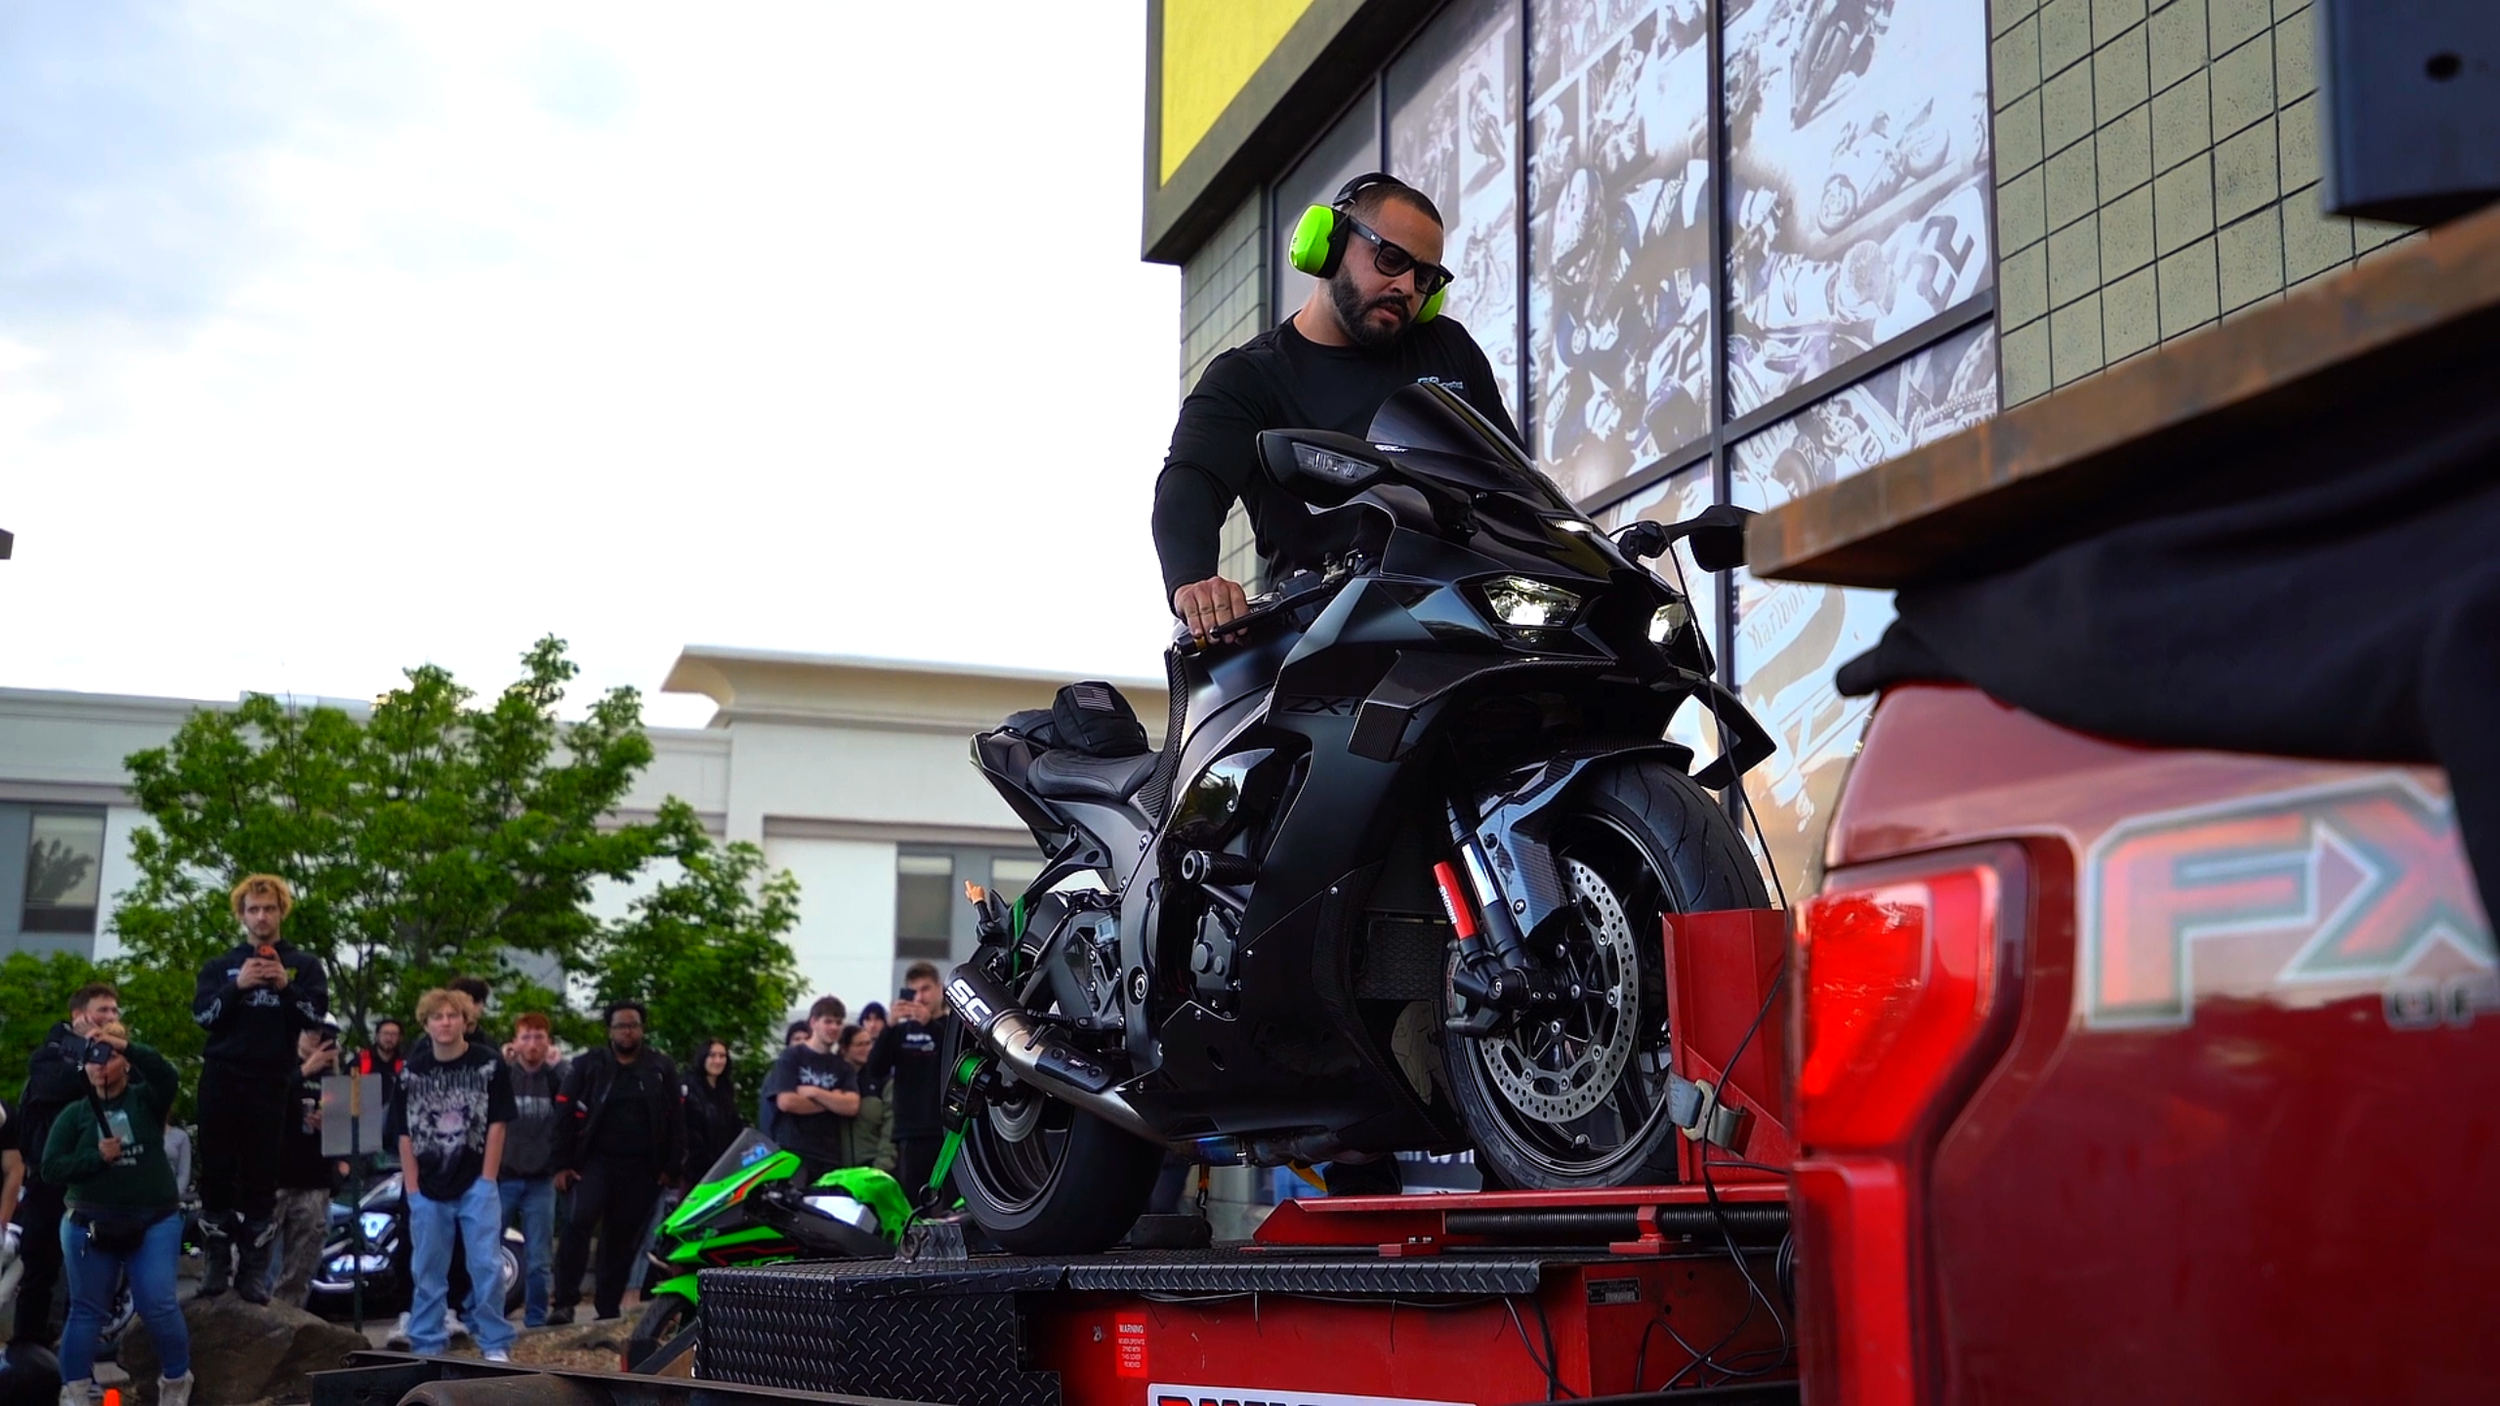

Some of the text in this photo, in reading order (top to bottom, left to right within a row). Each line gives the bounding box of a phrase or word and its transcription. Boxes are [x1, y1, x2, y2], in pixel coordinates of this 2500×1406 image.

[1438, 884, 1458, 925] SHOWA
[947, 979, 992, 1024] SC
[1118, 1324, 1144, 1334] WARNING
